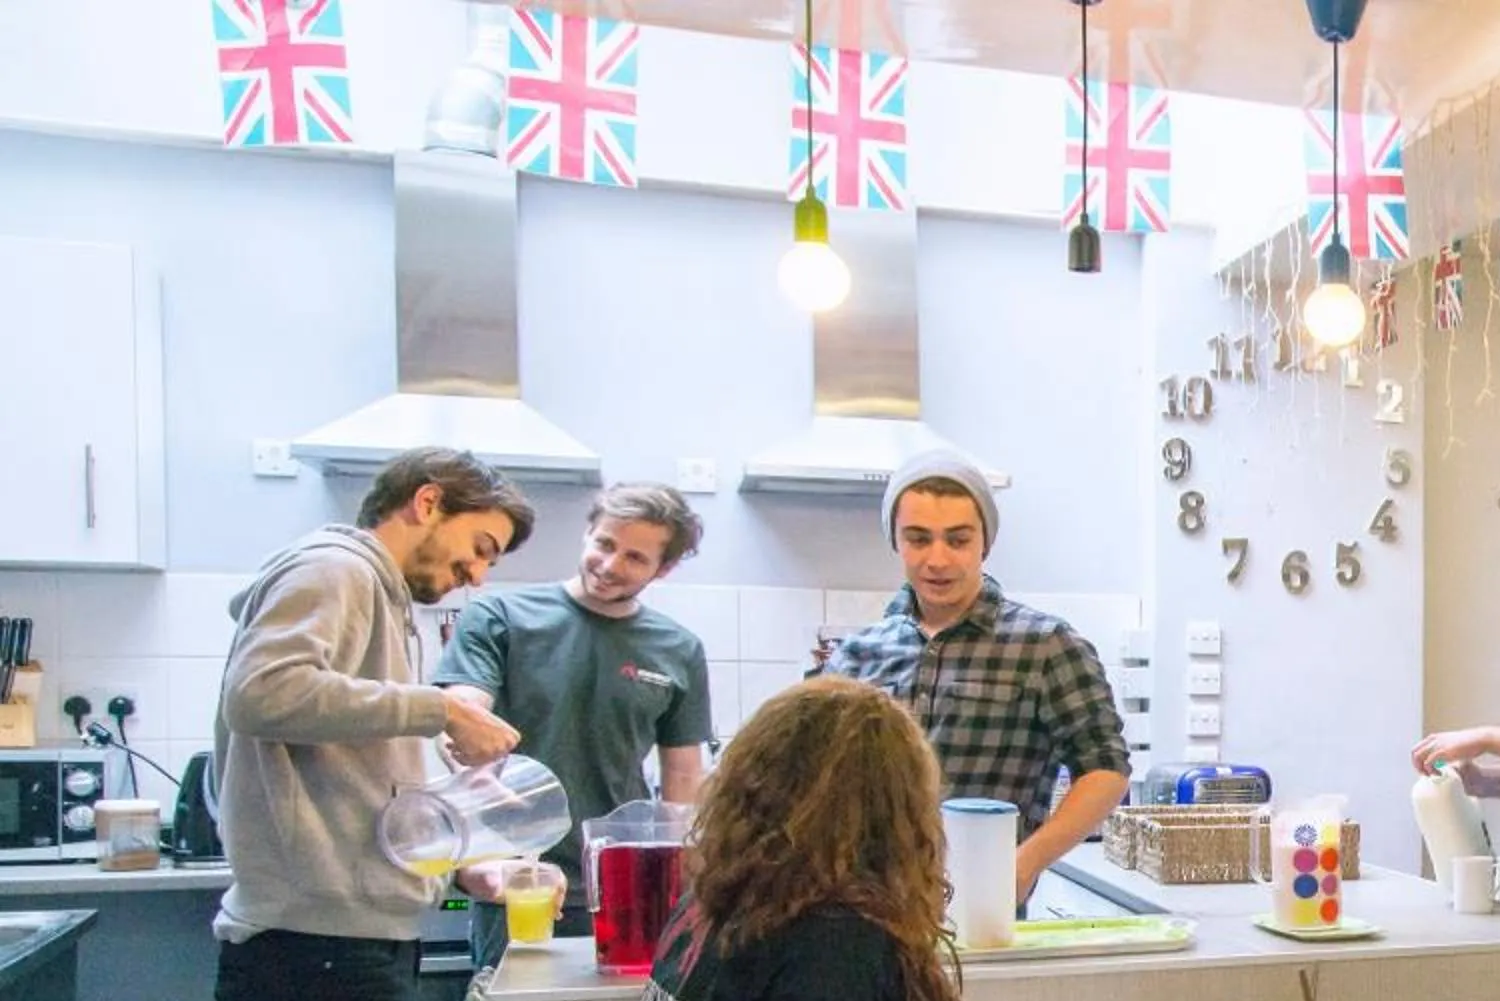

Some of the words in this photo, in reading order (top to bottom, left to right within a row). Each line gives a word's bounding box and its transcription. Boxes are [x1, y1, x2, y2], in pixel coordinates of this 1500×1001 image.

[1206, 332, 1258, 384] 11
[1159, 375, 1213, 422] 10
[1374, 377, 1405, 424] 2
[1162, 437, 1192, 481] 9
[1178, 490, 1206, 535] 8
[1369, 498, 1398, 543] 4
[1221, 536, 1249, 583] 7
[1281, 549, 1310, 595] 6
[1335, 540, 1361, 587] 5
